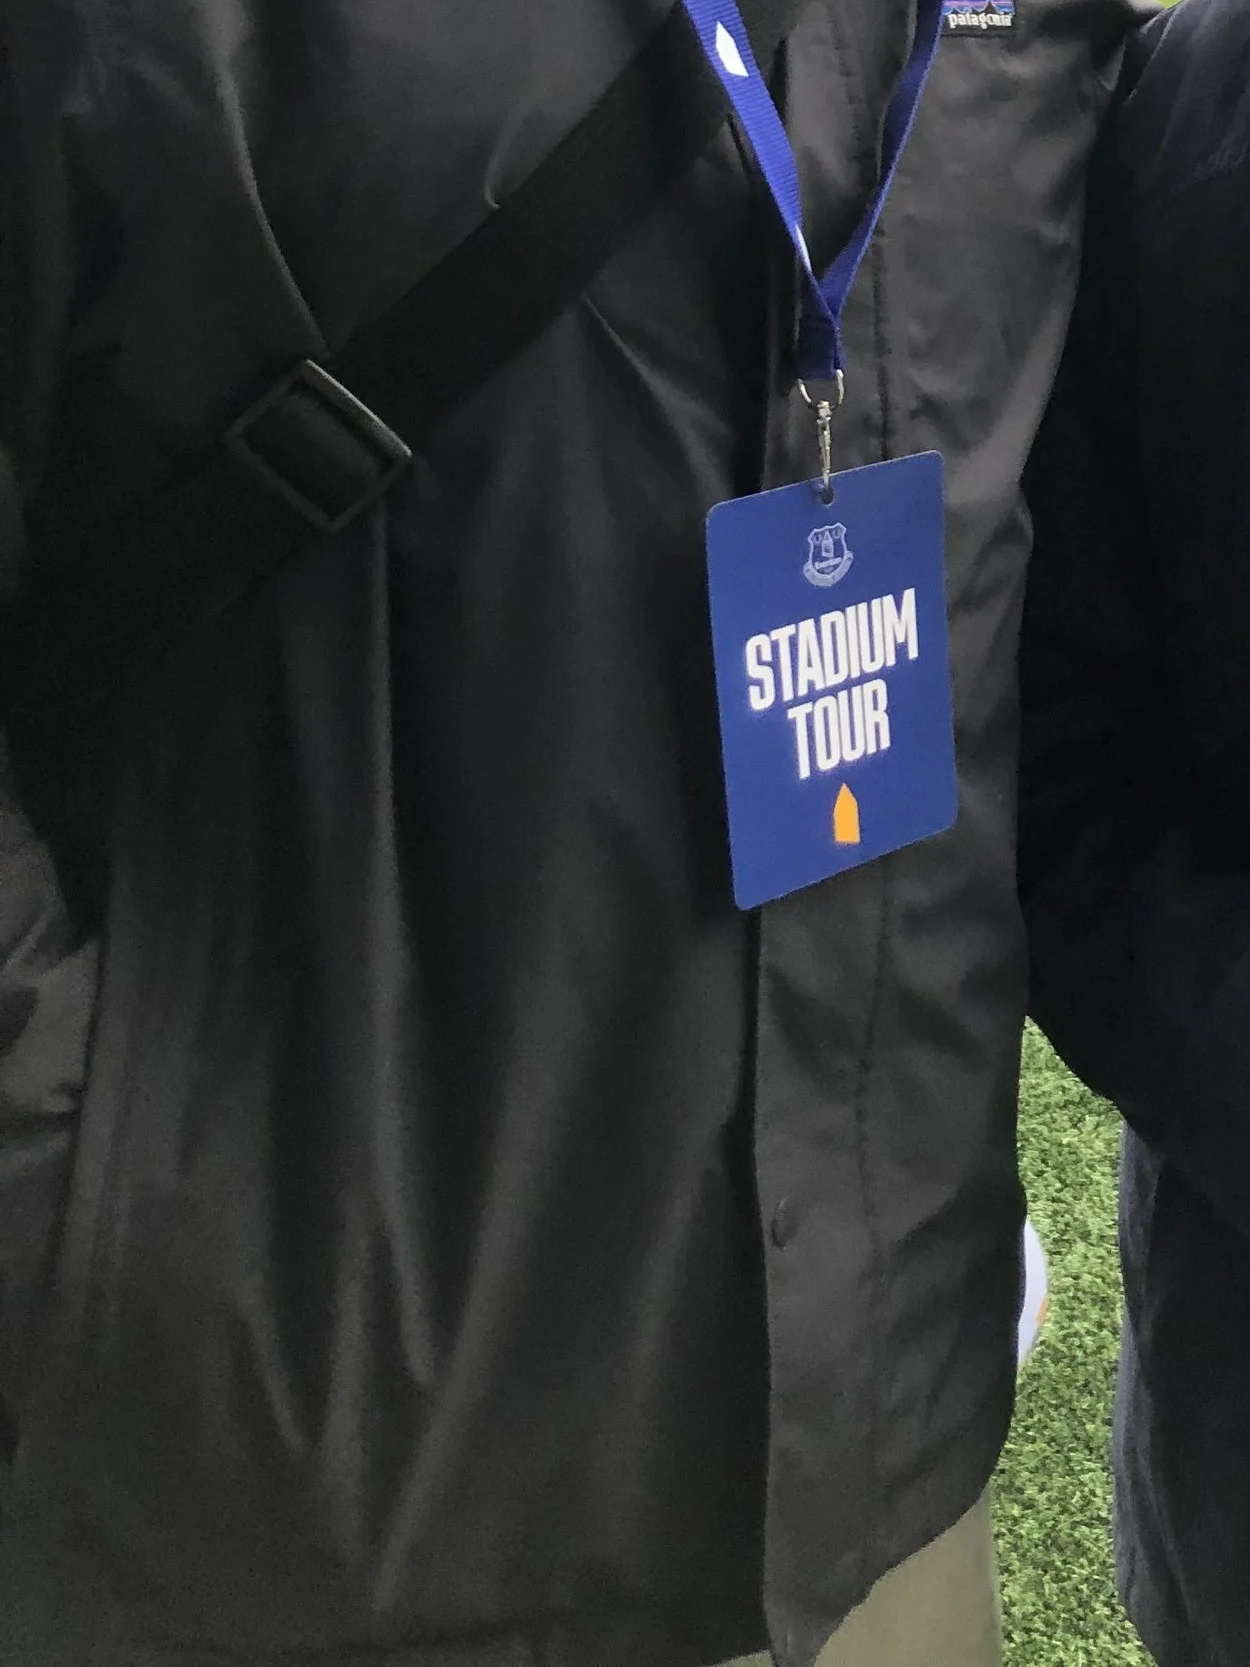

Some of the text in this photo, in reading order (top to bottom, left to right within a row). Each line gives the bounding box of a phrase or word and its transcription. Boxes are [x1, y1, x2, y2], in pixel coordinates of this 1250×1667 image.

[947, 11, 1013, 30] patagonia
[744, 587, 919, 712] STADIUM
[787, 678, 891, 780] TOUR
